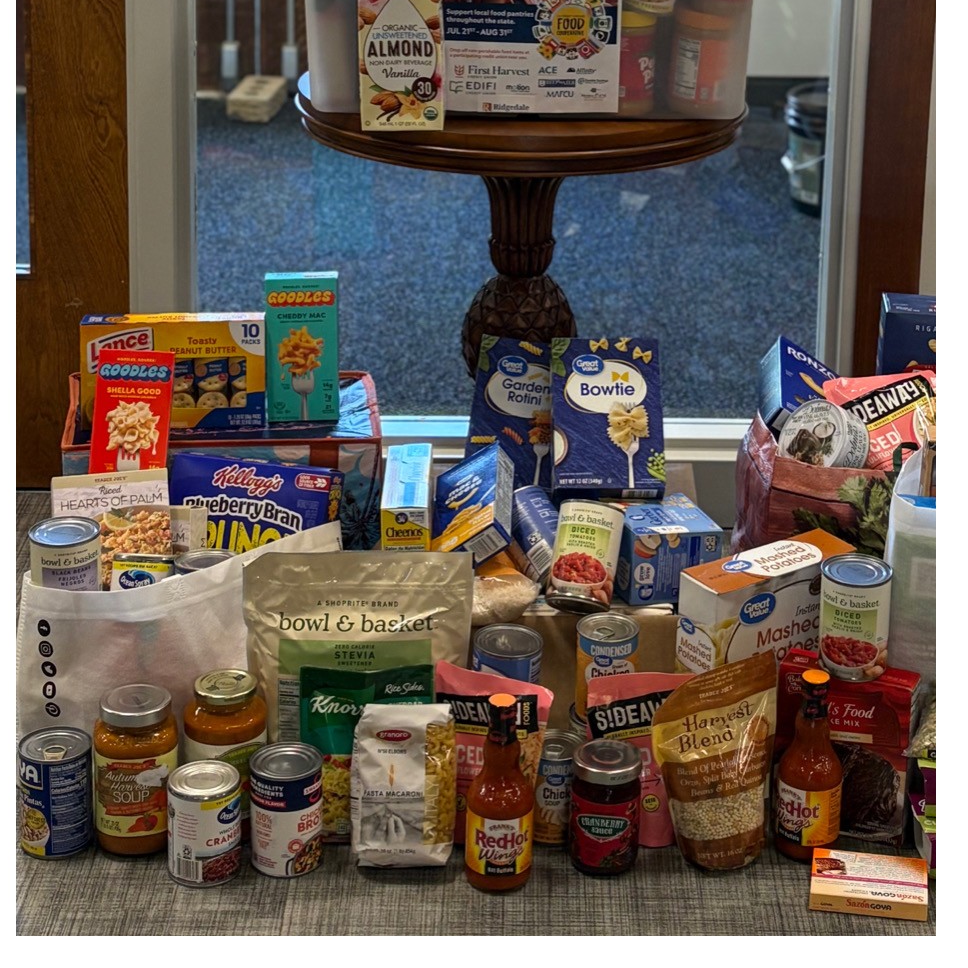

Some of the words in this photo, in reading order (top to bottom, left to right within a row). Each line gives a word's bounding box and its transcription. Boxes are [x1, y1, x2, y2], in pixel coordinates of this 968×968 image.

[557, 18, 584, 29] FOOD
[480, 28, 498, 36] AUG
[367, 40, 433, 57] ALMOND
[382, 67, 420, 78] Vanilla
[468, 65, 490, 74] First
[492, 66, 529, 76] Harvest
[538, 66, 557, 74] ACE
[417, 82, 431, 94] 30
[466, 81, 496, 90] EDIFI
[493, 103, 529, 111] Ridgedale
[268, 290, 332, 304] GOODLES
[241, 323, 260, 338] 10
[187, 337, 217, 346] Toasty
[170, 347, 203, 355] PEANUT
[205, 346, 237, 354] BUTTER
[576, 359, 598, 368] Great
[99, 363, 168, 380] GOODLES
[106, 386, 135, 394] SHELLA
[137, 387, 161, 395] GOOD
[502, 378, 551, 394] Garden
[580, 383, 635, 396] Bowtie
[507, 391, 542, 406] Rotini
[213, 464, 284, 496] Kellogg's
[99, 485, 122, 495] Riced
[60, 497, 108, 511] HEARTS
[110, 496, 129, 506] OF
[130, 492, 163, 504] PALM
[263, 503, 301, 530] Bran
[586, 516, 612, 528] basket
[571, 526, 596, 535] DICED
[41, 556, 61, 567] bowl
[73, 549, 99, 565] basket
[753, 546, 806, 565] Mashed
[762, 552, 816, 573] Potatoes
[744, 597, 770, 614] Great
[848, 599, 880, 609] basket
[834, 609, 861, 619] DICED
[279, 612, 329, 632] bowl
[336, 615, 354, 631] &
[361, 614, 433, 633] basket
[334, 650, 375, 660] STEVIA
[590, 642, 632, 657] CONDENSED
[680, 637, 712, 662] Mashed
[677, 645, 711, 671] Potatoes
[309, 696, 365, 717] Knorr
[843, 703, 875, 719] Food
[683, 700, 754, 733] Harvest
[678, 724, 734, 753] Blend
[113, 791, 150, 803] SOUP
[581, 817, 626, 829] CRANBERRY
[475, 827, 529, 848] RedHot
[478, 845, 524, 866] Wings
[845, 898, 870, 910] Sazón
[870, 903, 892, 911] GOYA
